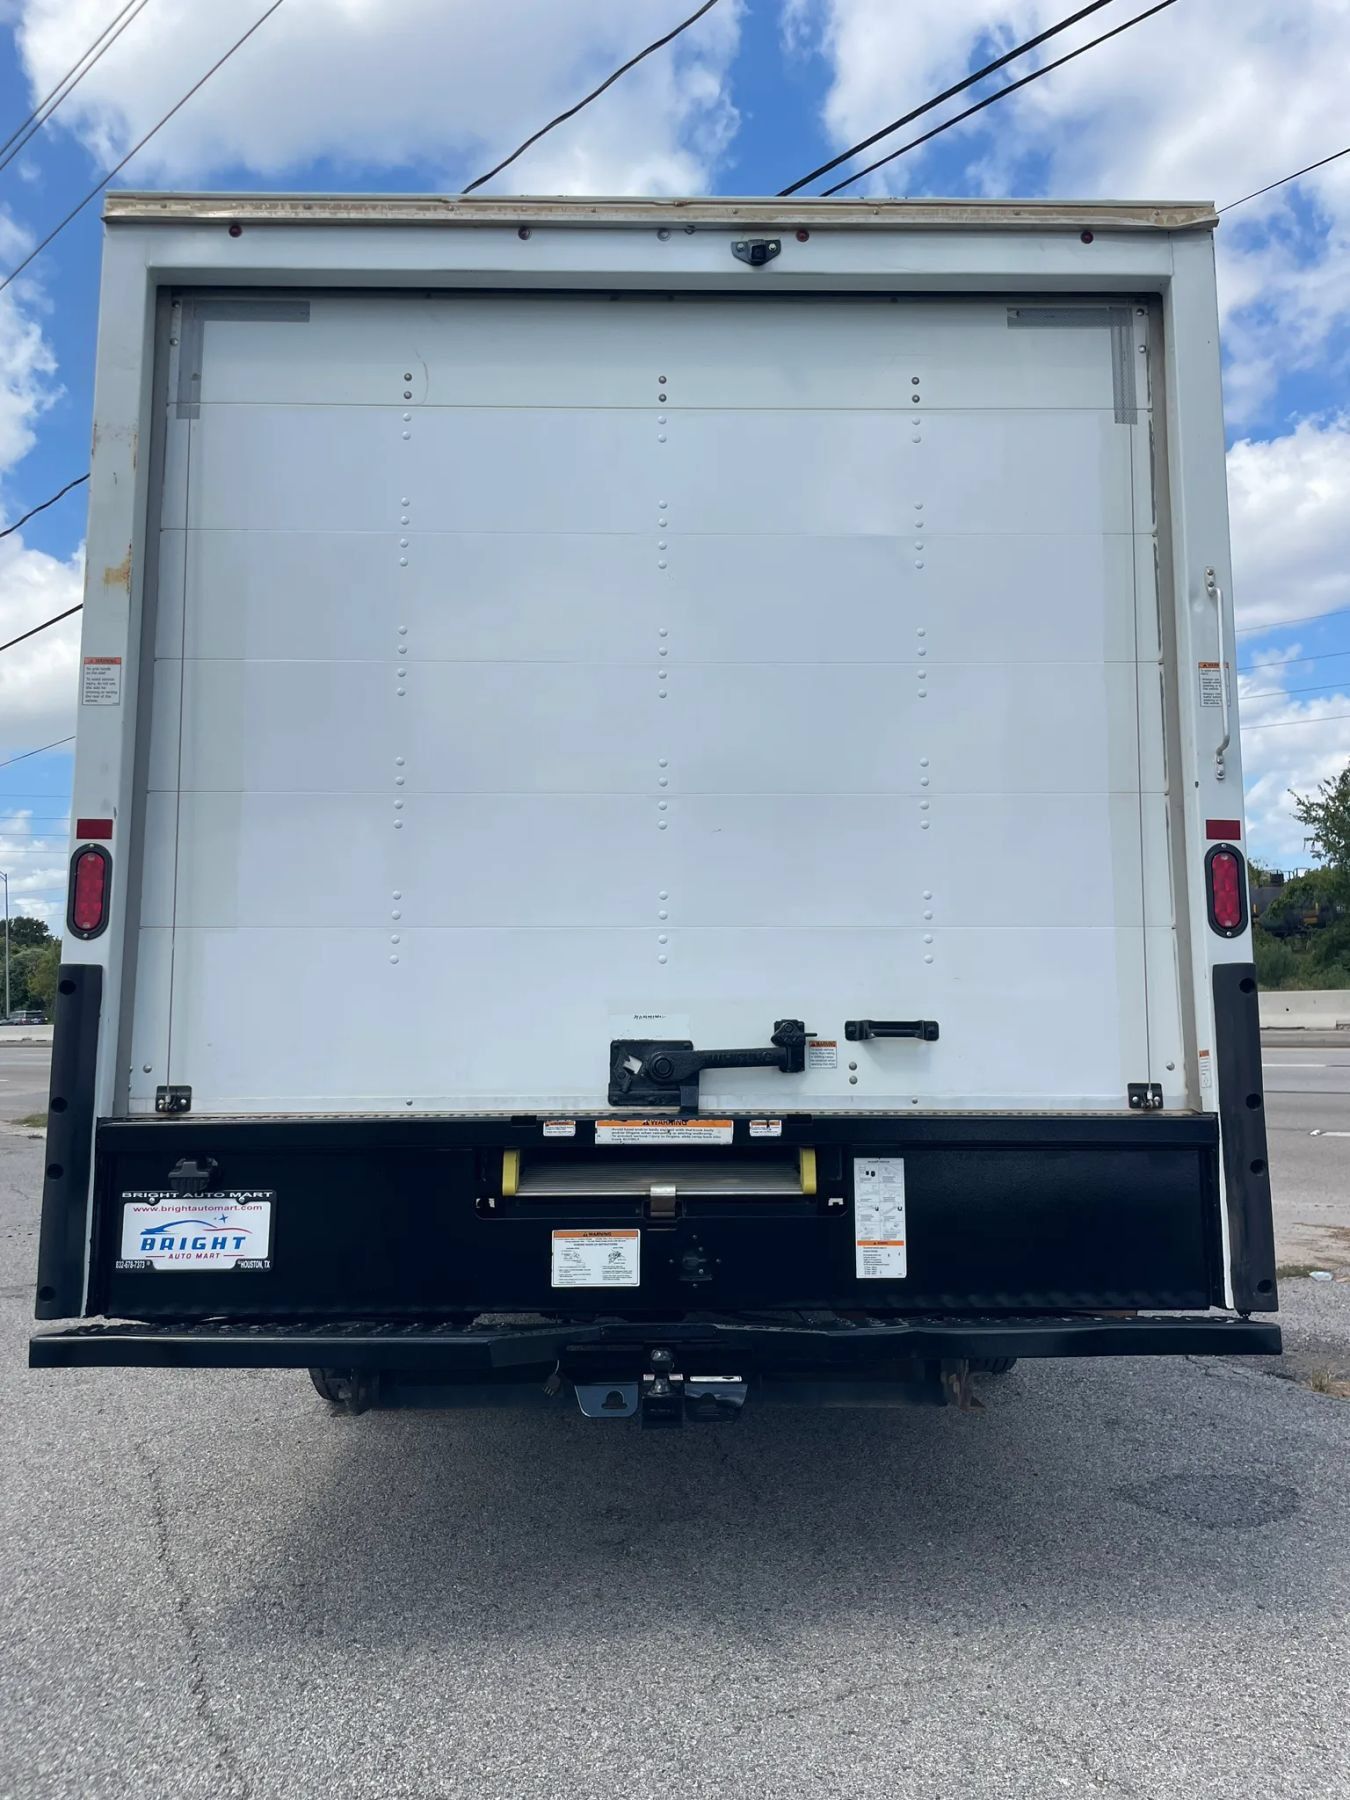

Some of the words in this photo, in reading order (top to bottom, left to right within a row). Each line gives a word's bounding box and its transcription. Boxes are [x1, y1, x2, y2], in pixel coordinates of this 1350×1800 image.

[133, 1204, 263, 1213] www.brightautomart.com
[140, 1236, 246, 1251] BRIGHT
[240, 1260, 263, 1270] HOUSTON,
[263, 1260, 271, 1269] TX
